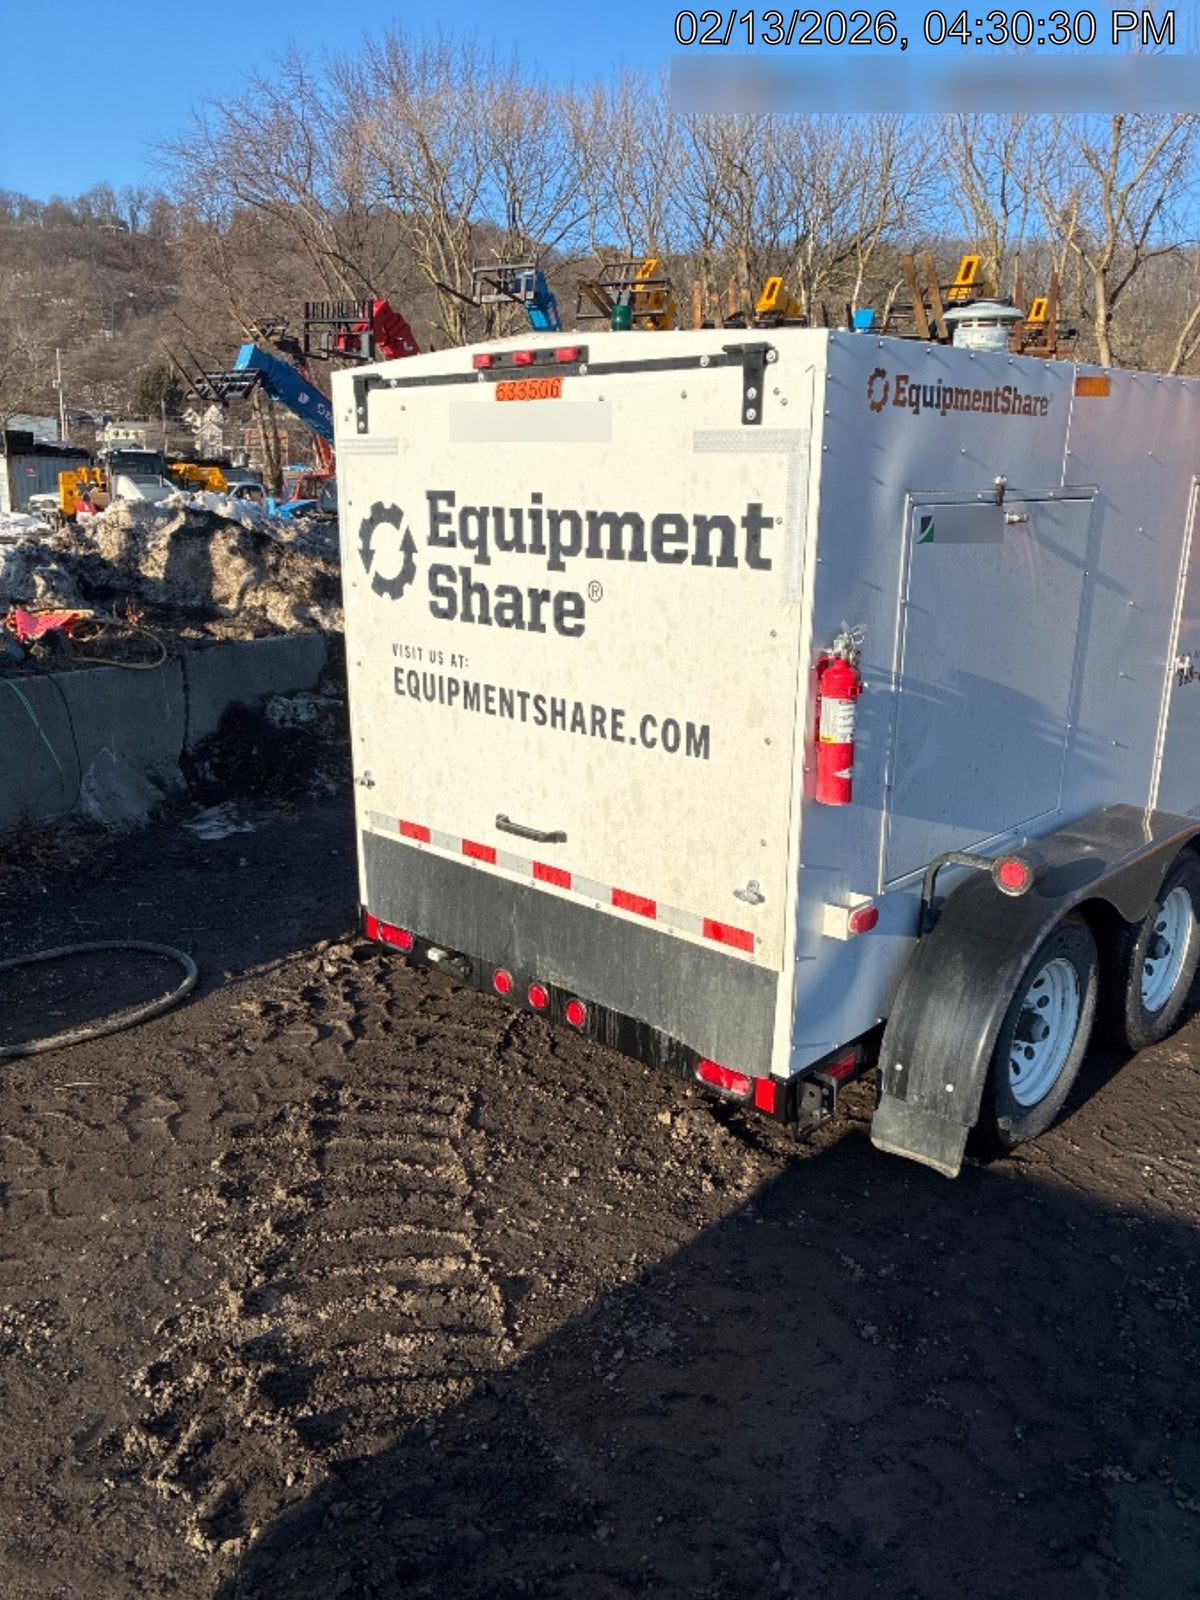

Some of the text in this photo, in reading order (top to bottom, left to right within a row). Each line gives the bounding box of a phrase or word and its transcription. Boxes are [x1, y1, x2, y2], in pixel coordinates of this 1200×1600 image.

[496, 378, 562, 400] 633506
[893, 375, 1049, 417] EquipmentShare
[425, 490, 774, 573] Equipment
[392, 643, 469, 669] VISIT US AT:
[393, 666, 711, 760] EQUIPMENTSHARE.COM
